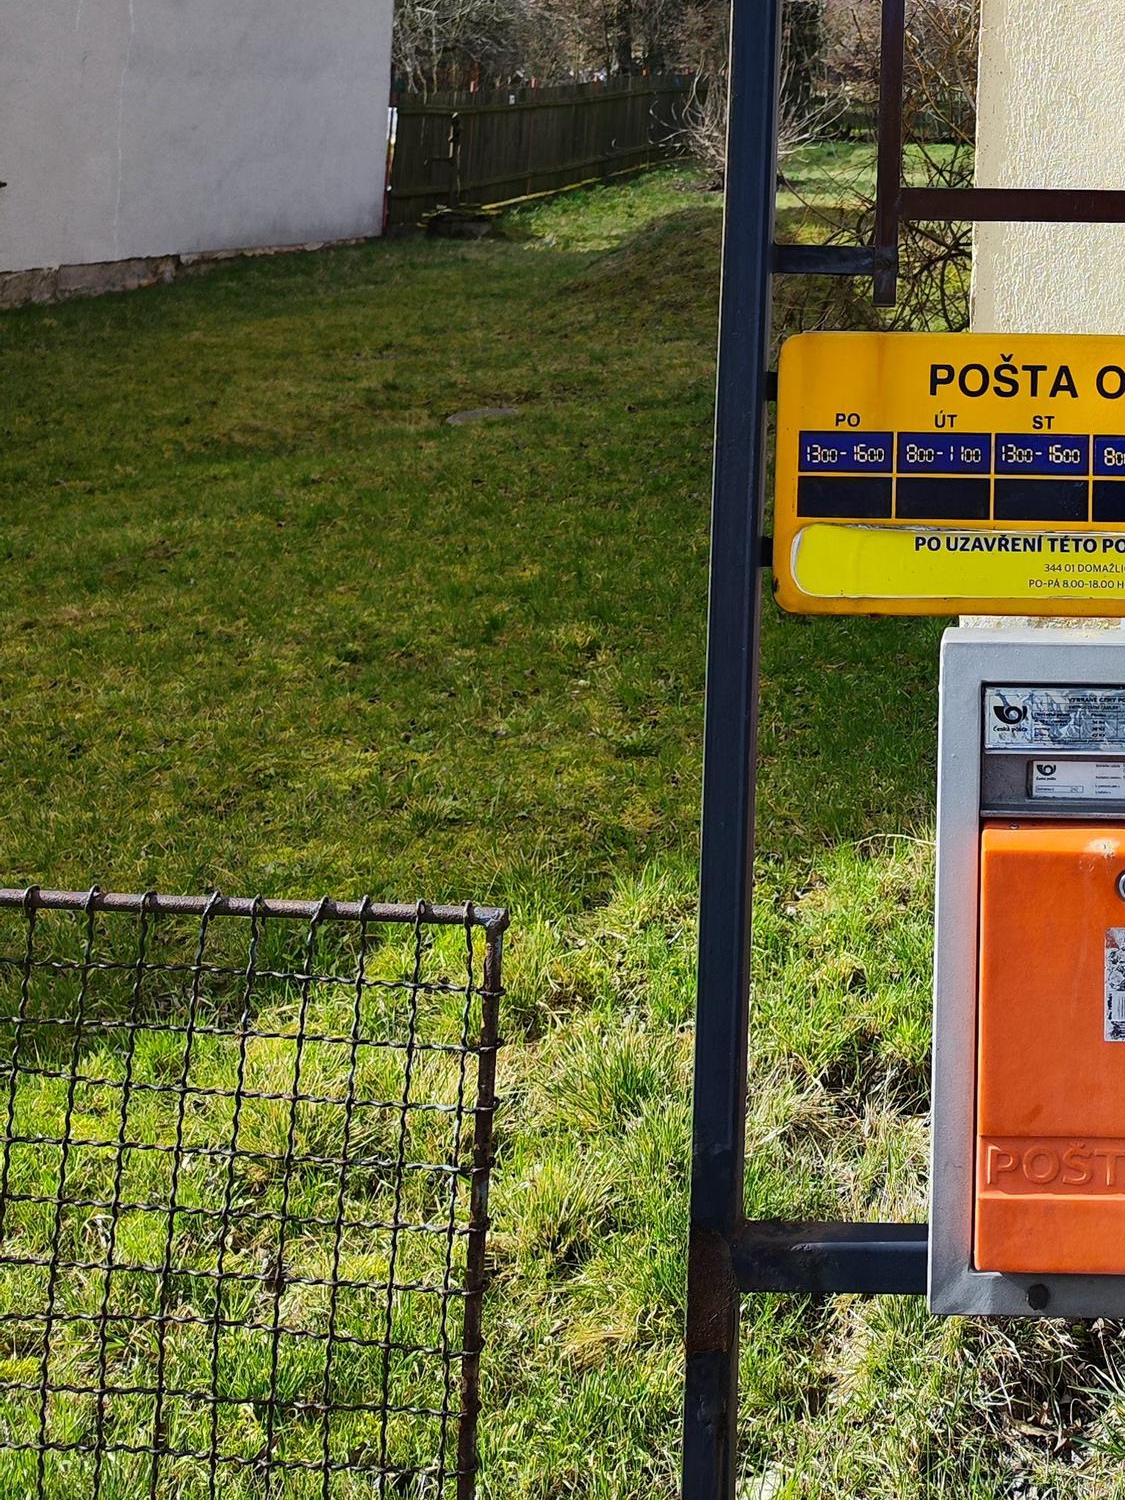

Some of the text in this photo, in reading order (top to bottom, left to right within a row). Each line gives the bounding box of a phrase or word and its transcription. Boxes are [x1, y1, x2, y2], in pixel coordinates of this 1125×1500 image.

[929, 353, 1079, 398] POŠTA
[835, 413, 861, 427] PO
[934, 410, 958, 428] ÚT
[1032, 415, 1055, 430] ST
[915, 536, 941, 552] PO
[946, 534, 1042, 553] UZAVŘENÍ
[1048, 535, 1098, 554] TÉTO
[1044, 563, 1062, 573] 344
[1064, 564, 1075, 573] 01
[1029, 579, 1060, 589] PO-PÁ
[1062, 580, 1115, 589] 8.00-18.00
